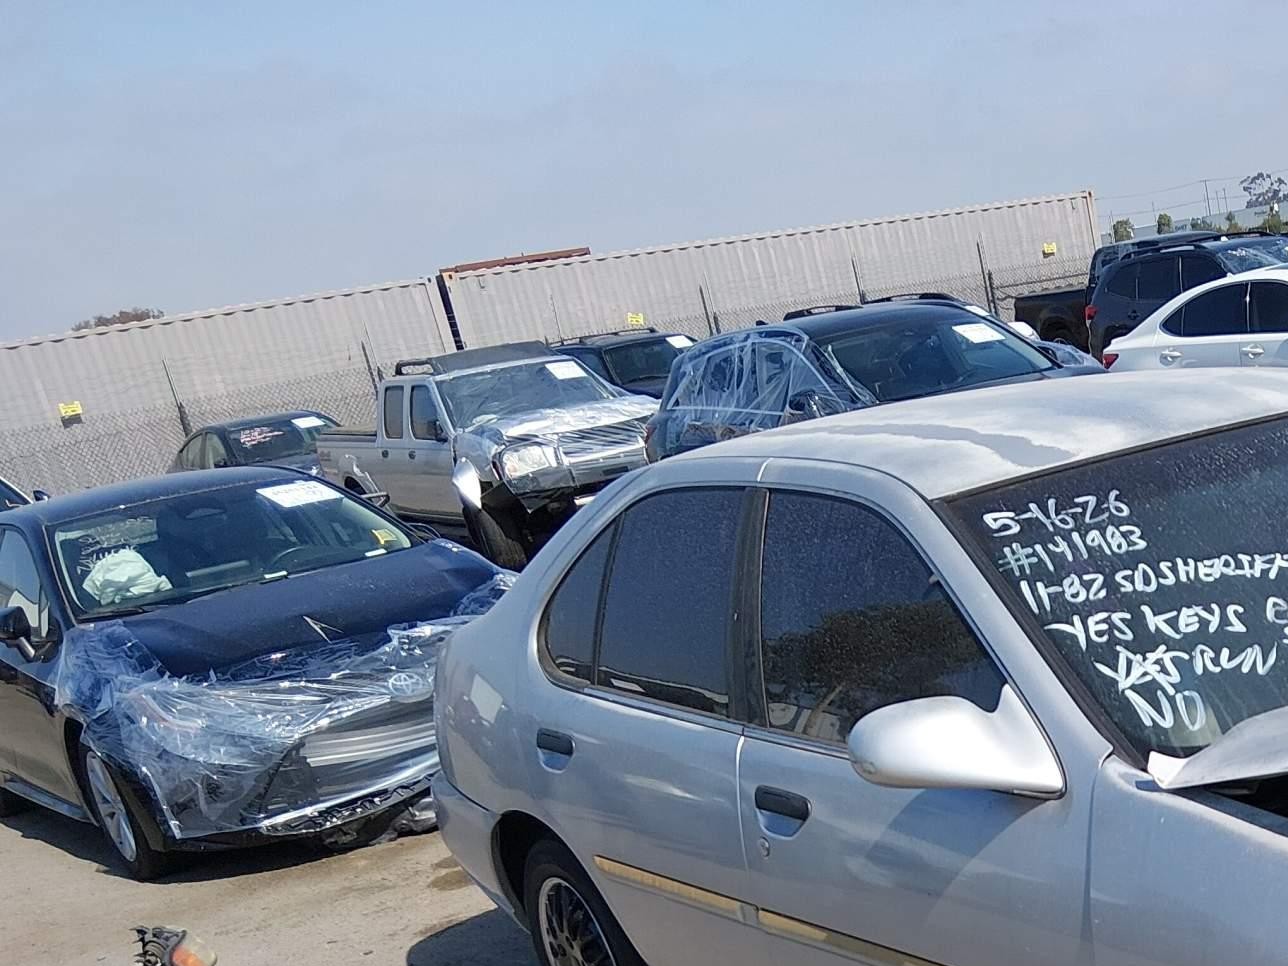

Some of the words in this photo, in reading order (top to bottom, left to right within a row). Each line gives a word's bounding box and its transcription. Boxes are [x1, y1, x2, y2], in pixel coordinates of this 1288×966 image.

[1043, 611, 1134, 651] YES
[1140, 603, 1248, 639] KEYS
[1193, 641, 1278, 676] RUN
[1123, 688, 1206, 731] NO
